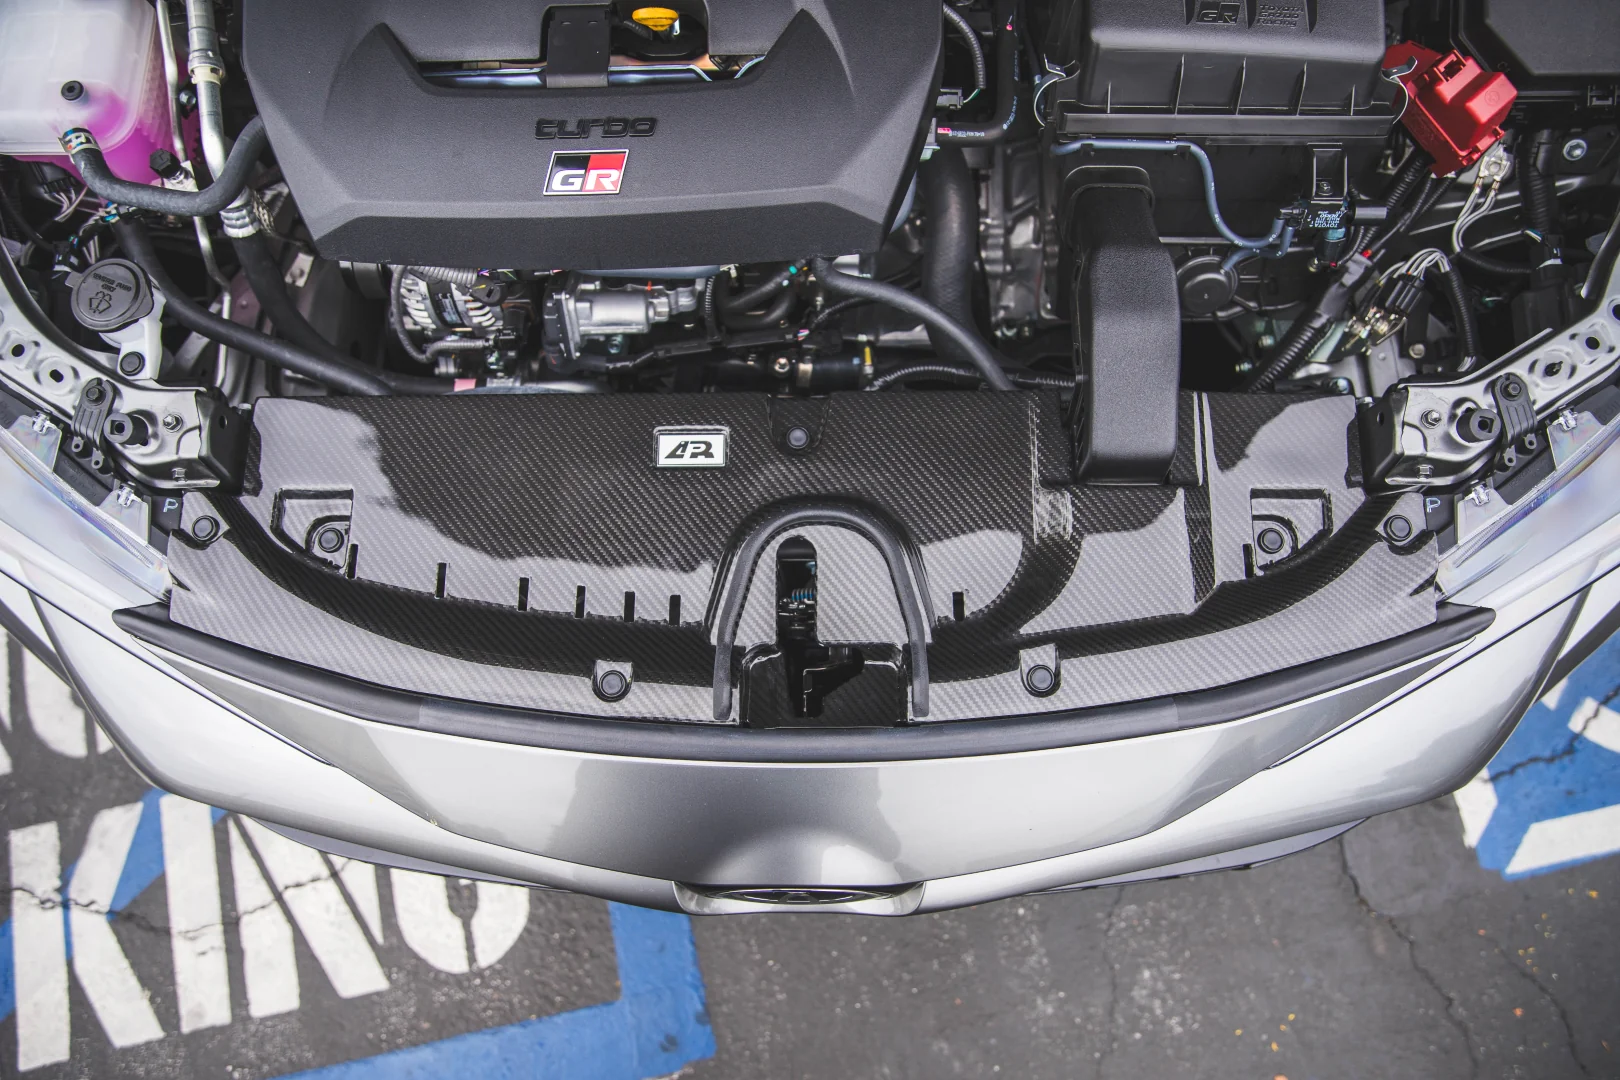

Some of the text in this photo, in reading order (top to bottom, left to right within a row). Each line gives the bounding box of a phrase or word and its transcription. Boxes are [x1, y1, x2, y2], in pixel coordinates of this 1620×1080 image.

[1259, 4, 1304, 13] TOYOTA
[1199, 9, 1238, 24] GR
[551, 169, 620, 191] GR
[163, 498, 179, 513] P
[1426, 498, 1441, 513] P
